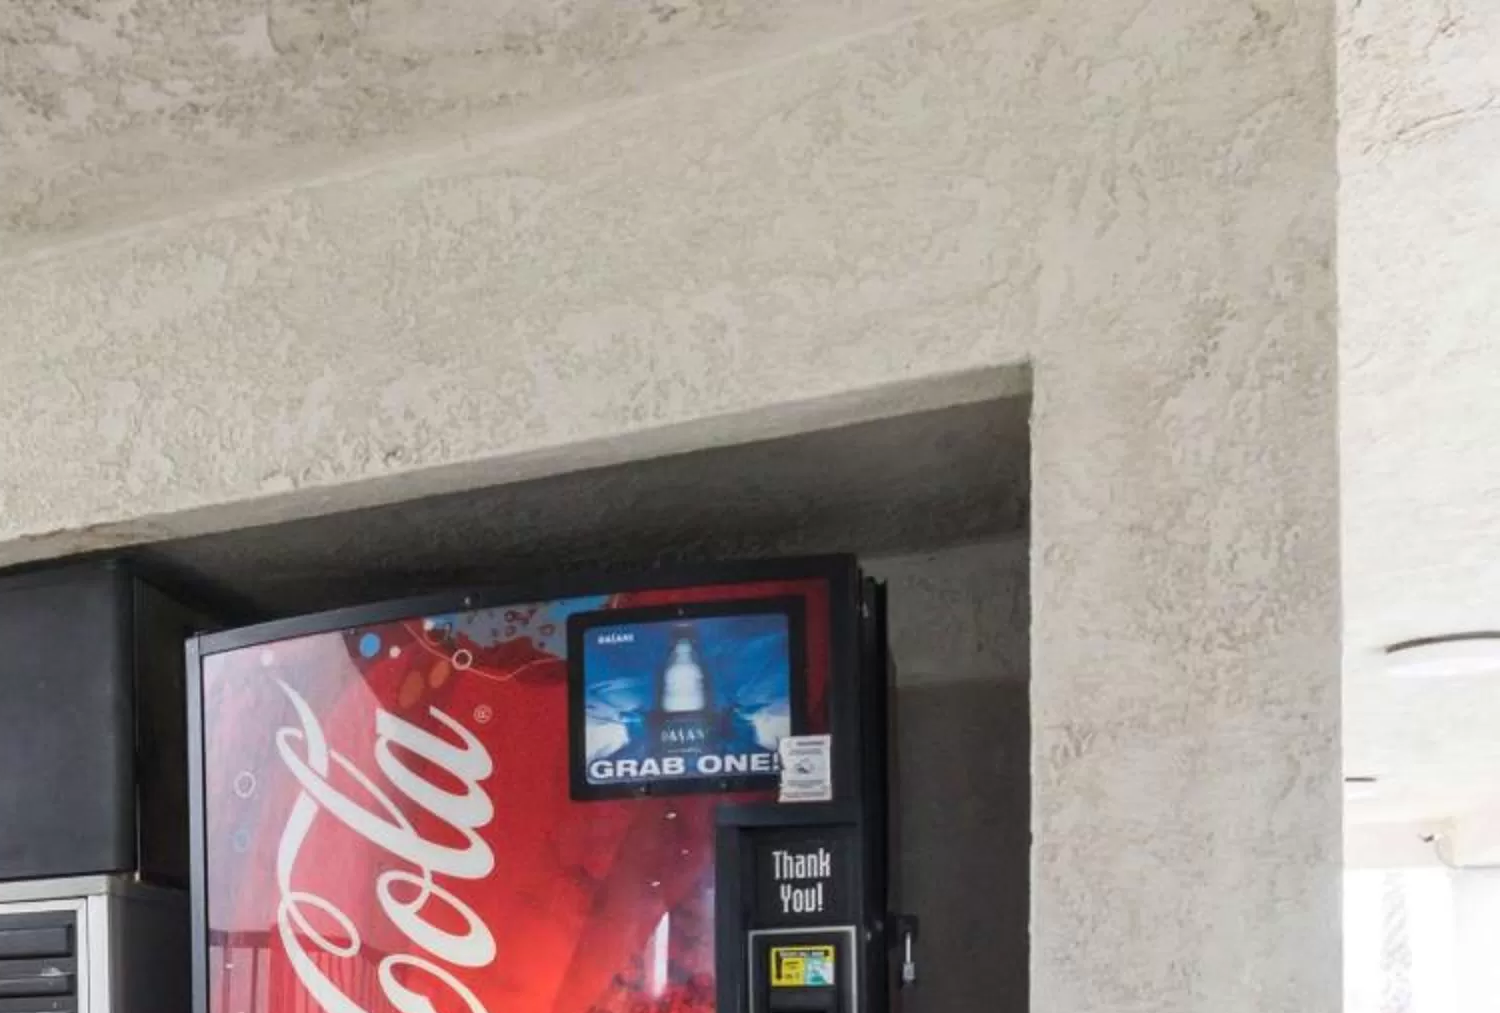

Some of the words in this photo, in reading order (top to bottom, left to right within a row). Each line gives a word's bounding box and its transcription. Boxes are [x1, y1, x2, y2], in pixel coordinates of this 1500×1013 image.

[589, 756, 685, 779] GRAB
[696, 753, 780, 774] ONE!
[771, 848, 831, 880] Thank
[780, 882, 823, 913] You!
